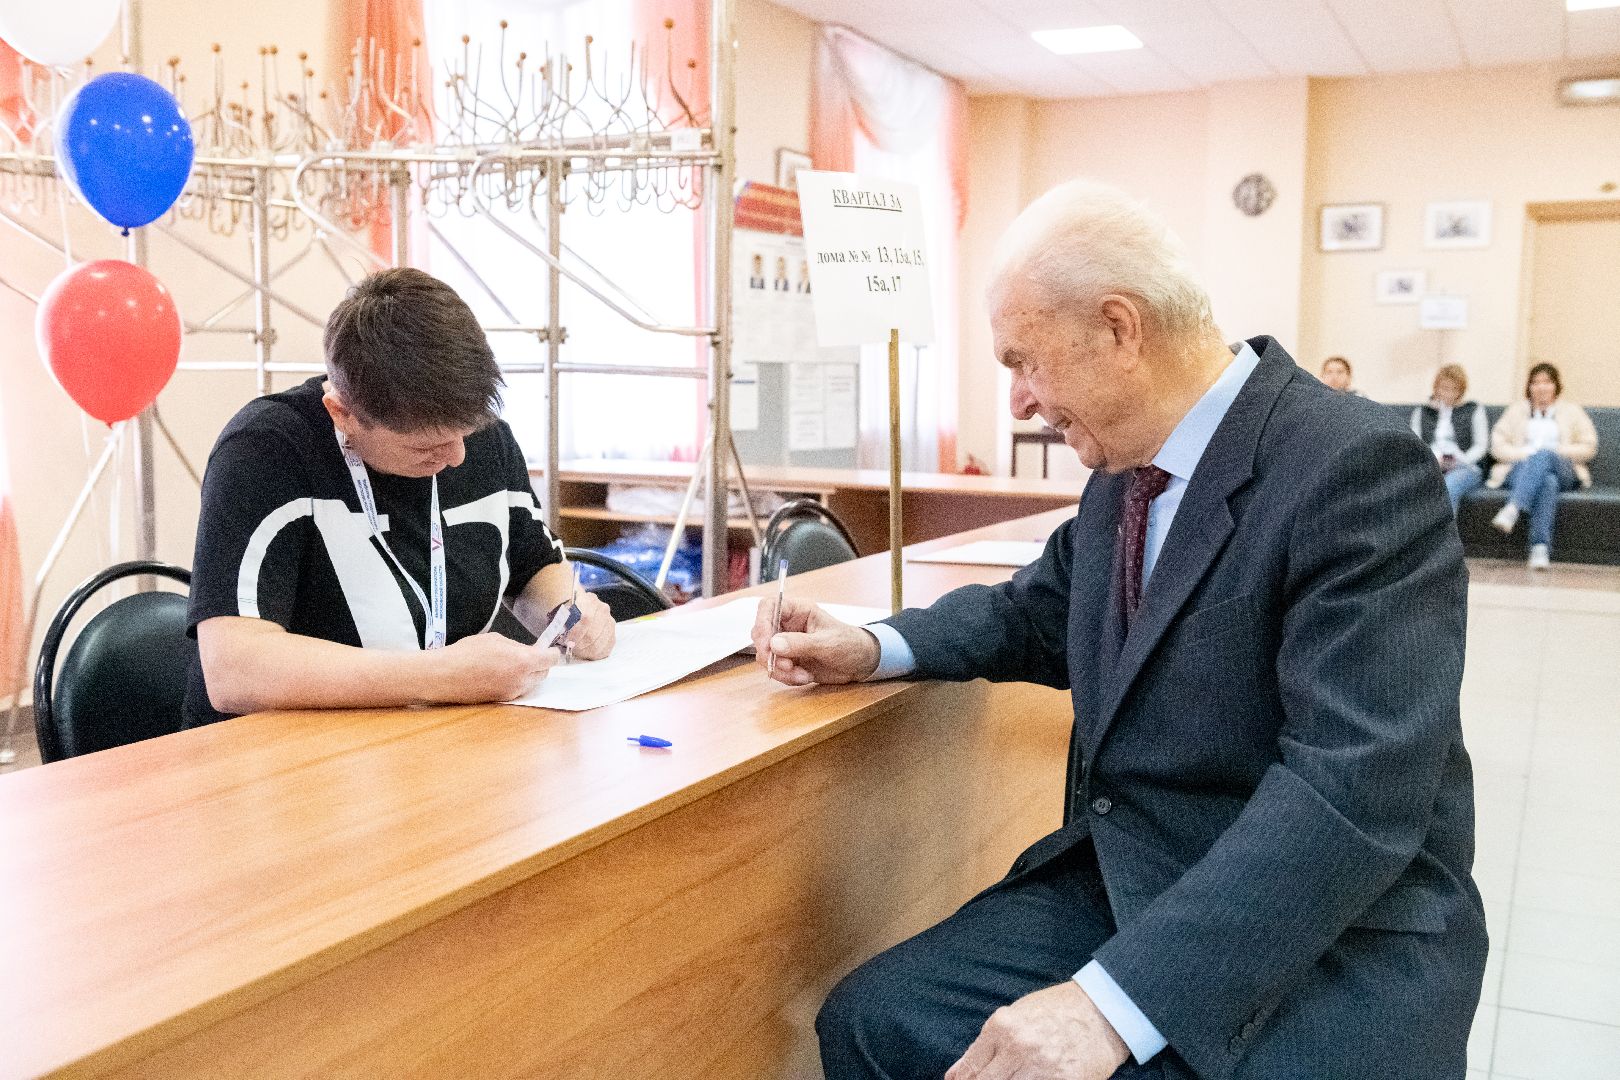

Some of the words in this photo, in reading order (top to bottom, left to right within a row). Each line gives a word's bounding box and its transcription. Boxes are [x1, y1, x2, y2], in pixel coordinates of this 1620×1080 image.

[832, 189, 887, 207] КВАРТАЛ
[817, 251, 846, 264] дома
[877, 246, 893, 265] 13,
[866, 275, 891, 294] 15а,
[892, 275, 902, 292] 17
